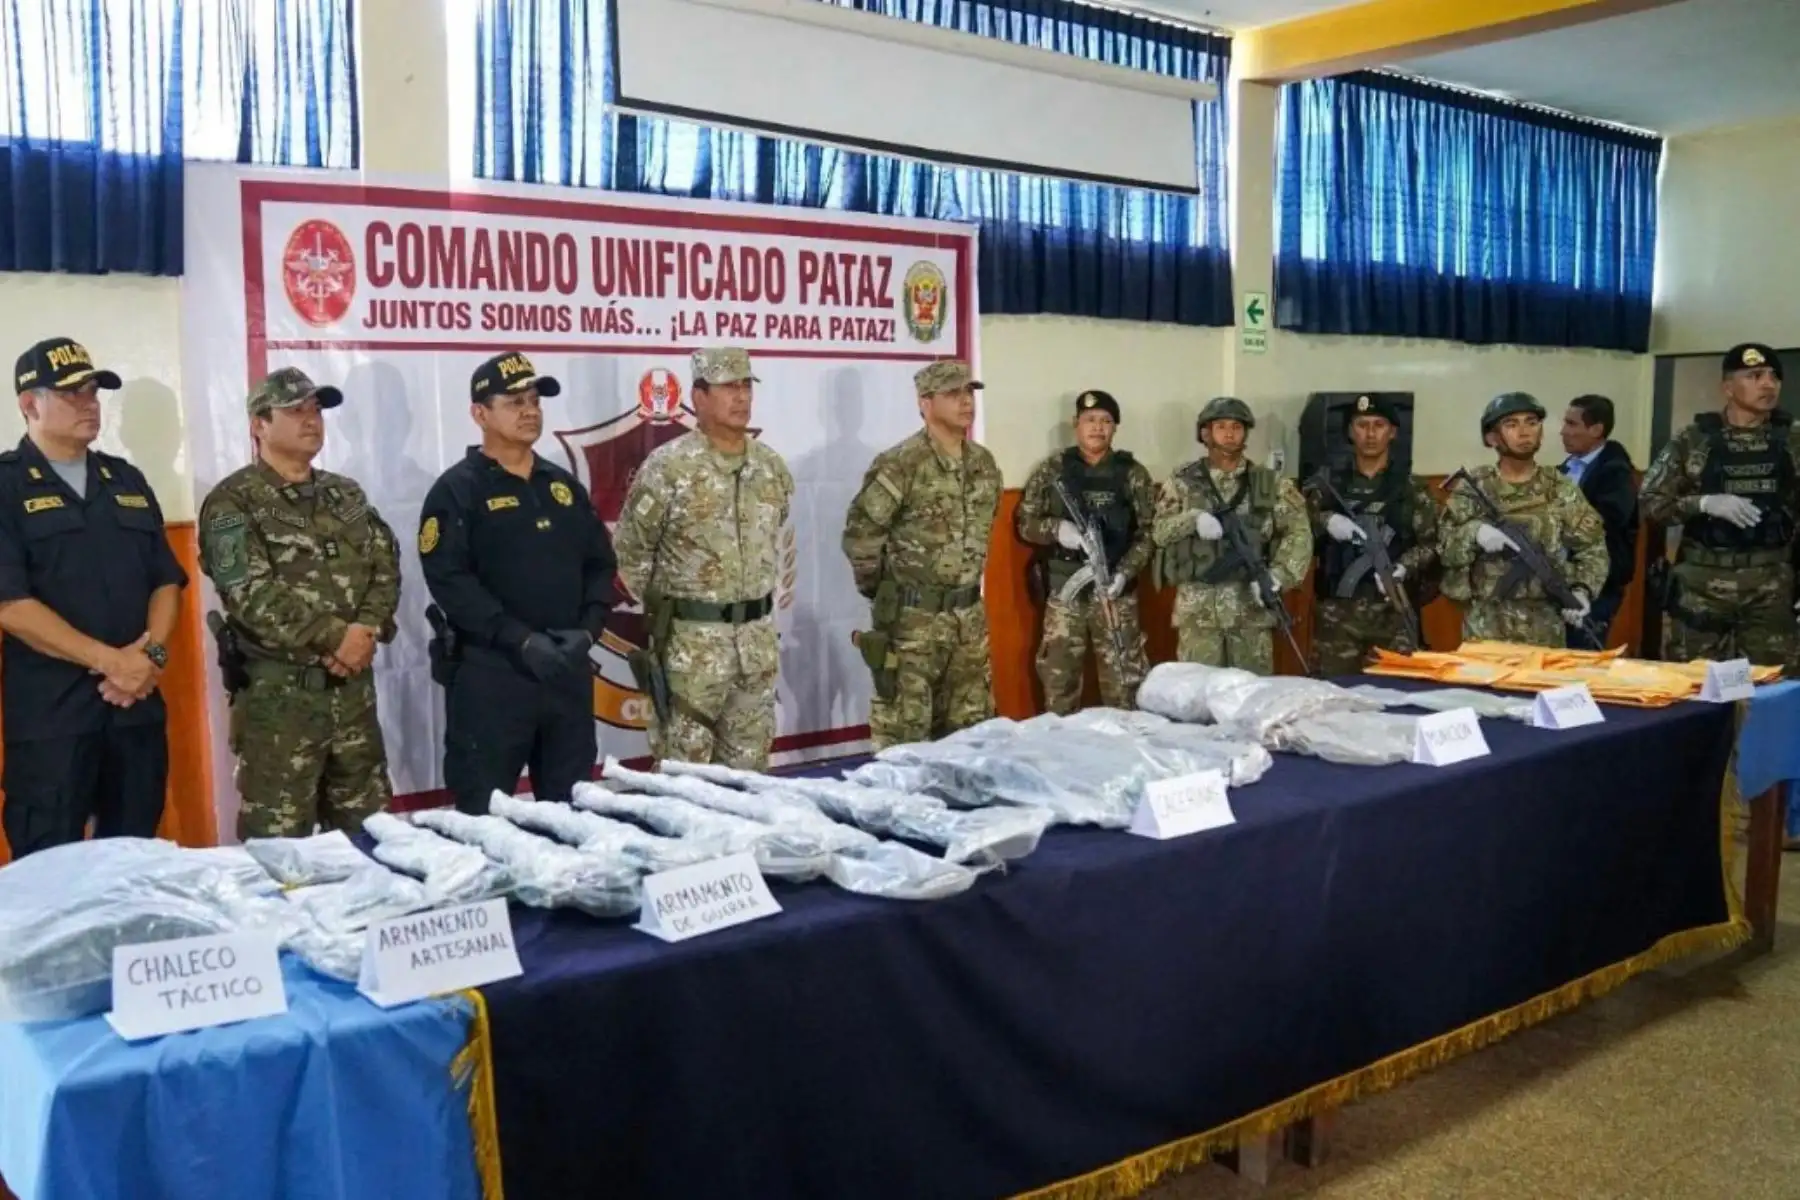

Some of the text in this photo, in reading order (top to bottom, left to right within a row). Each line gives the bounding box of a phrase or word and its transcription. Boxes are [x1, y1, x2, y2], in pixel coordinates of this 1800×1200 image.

[365, 220, 894, 308] COMANDO UNIFICADO PATAZ
[363, 299, 897, 342] JUNTOS SOMOS MÁS... ¡LA PAZ PARA PATAZ!
[656, 872, 754, 919] ARMAMENTO
[378, 906, 488, 952] ARMAMENTO
[672, 915, 695, 933] DE
[127, 946, 237, 986] CHALECO
[410, 931, 509, 970] ARTESANAL
[157, 976, 263, 1009] TÁCTICO
